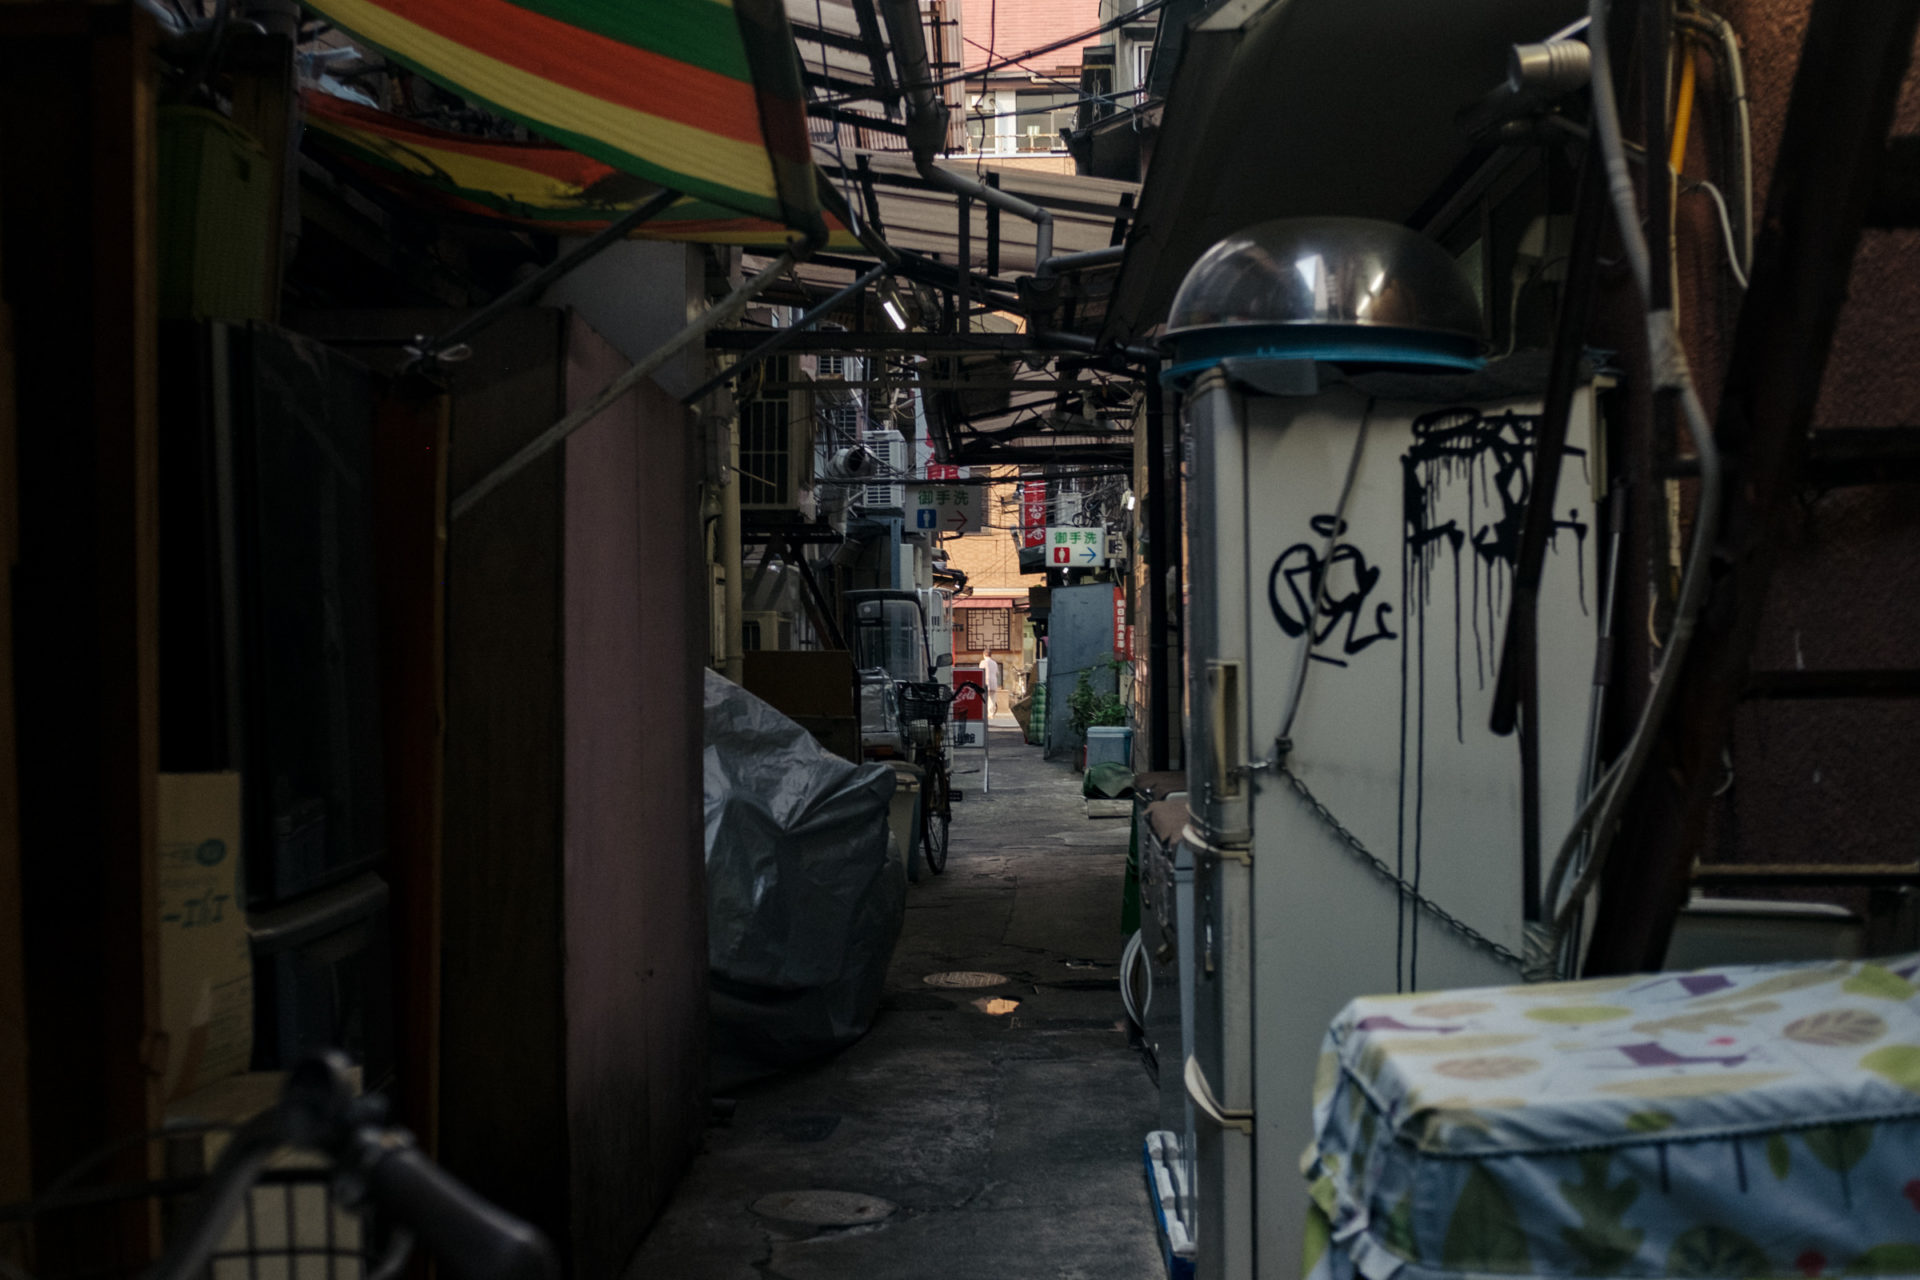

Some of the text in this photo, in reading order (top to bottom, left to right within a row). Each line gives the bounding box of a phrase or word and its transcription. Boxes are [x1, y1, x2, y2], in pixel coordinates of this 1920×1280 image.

[918, 489, 969, 506] 御手洗
[1054, 531, 1097, 544] 御手洗
